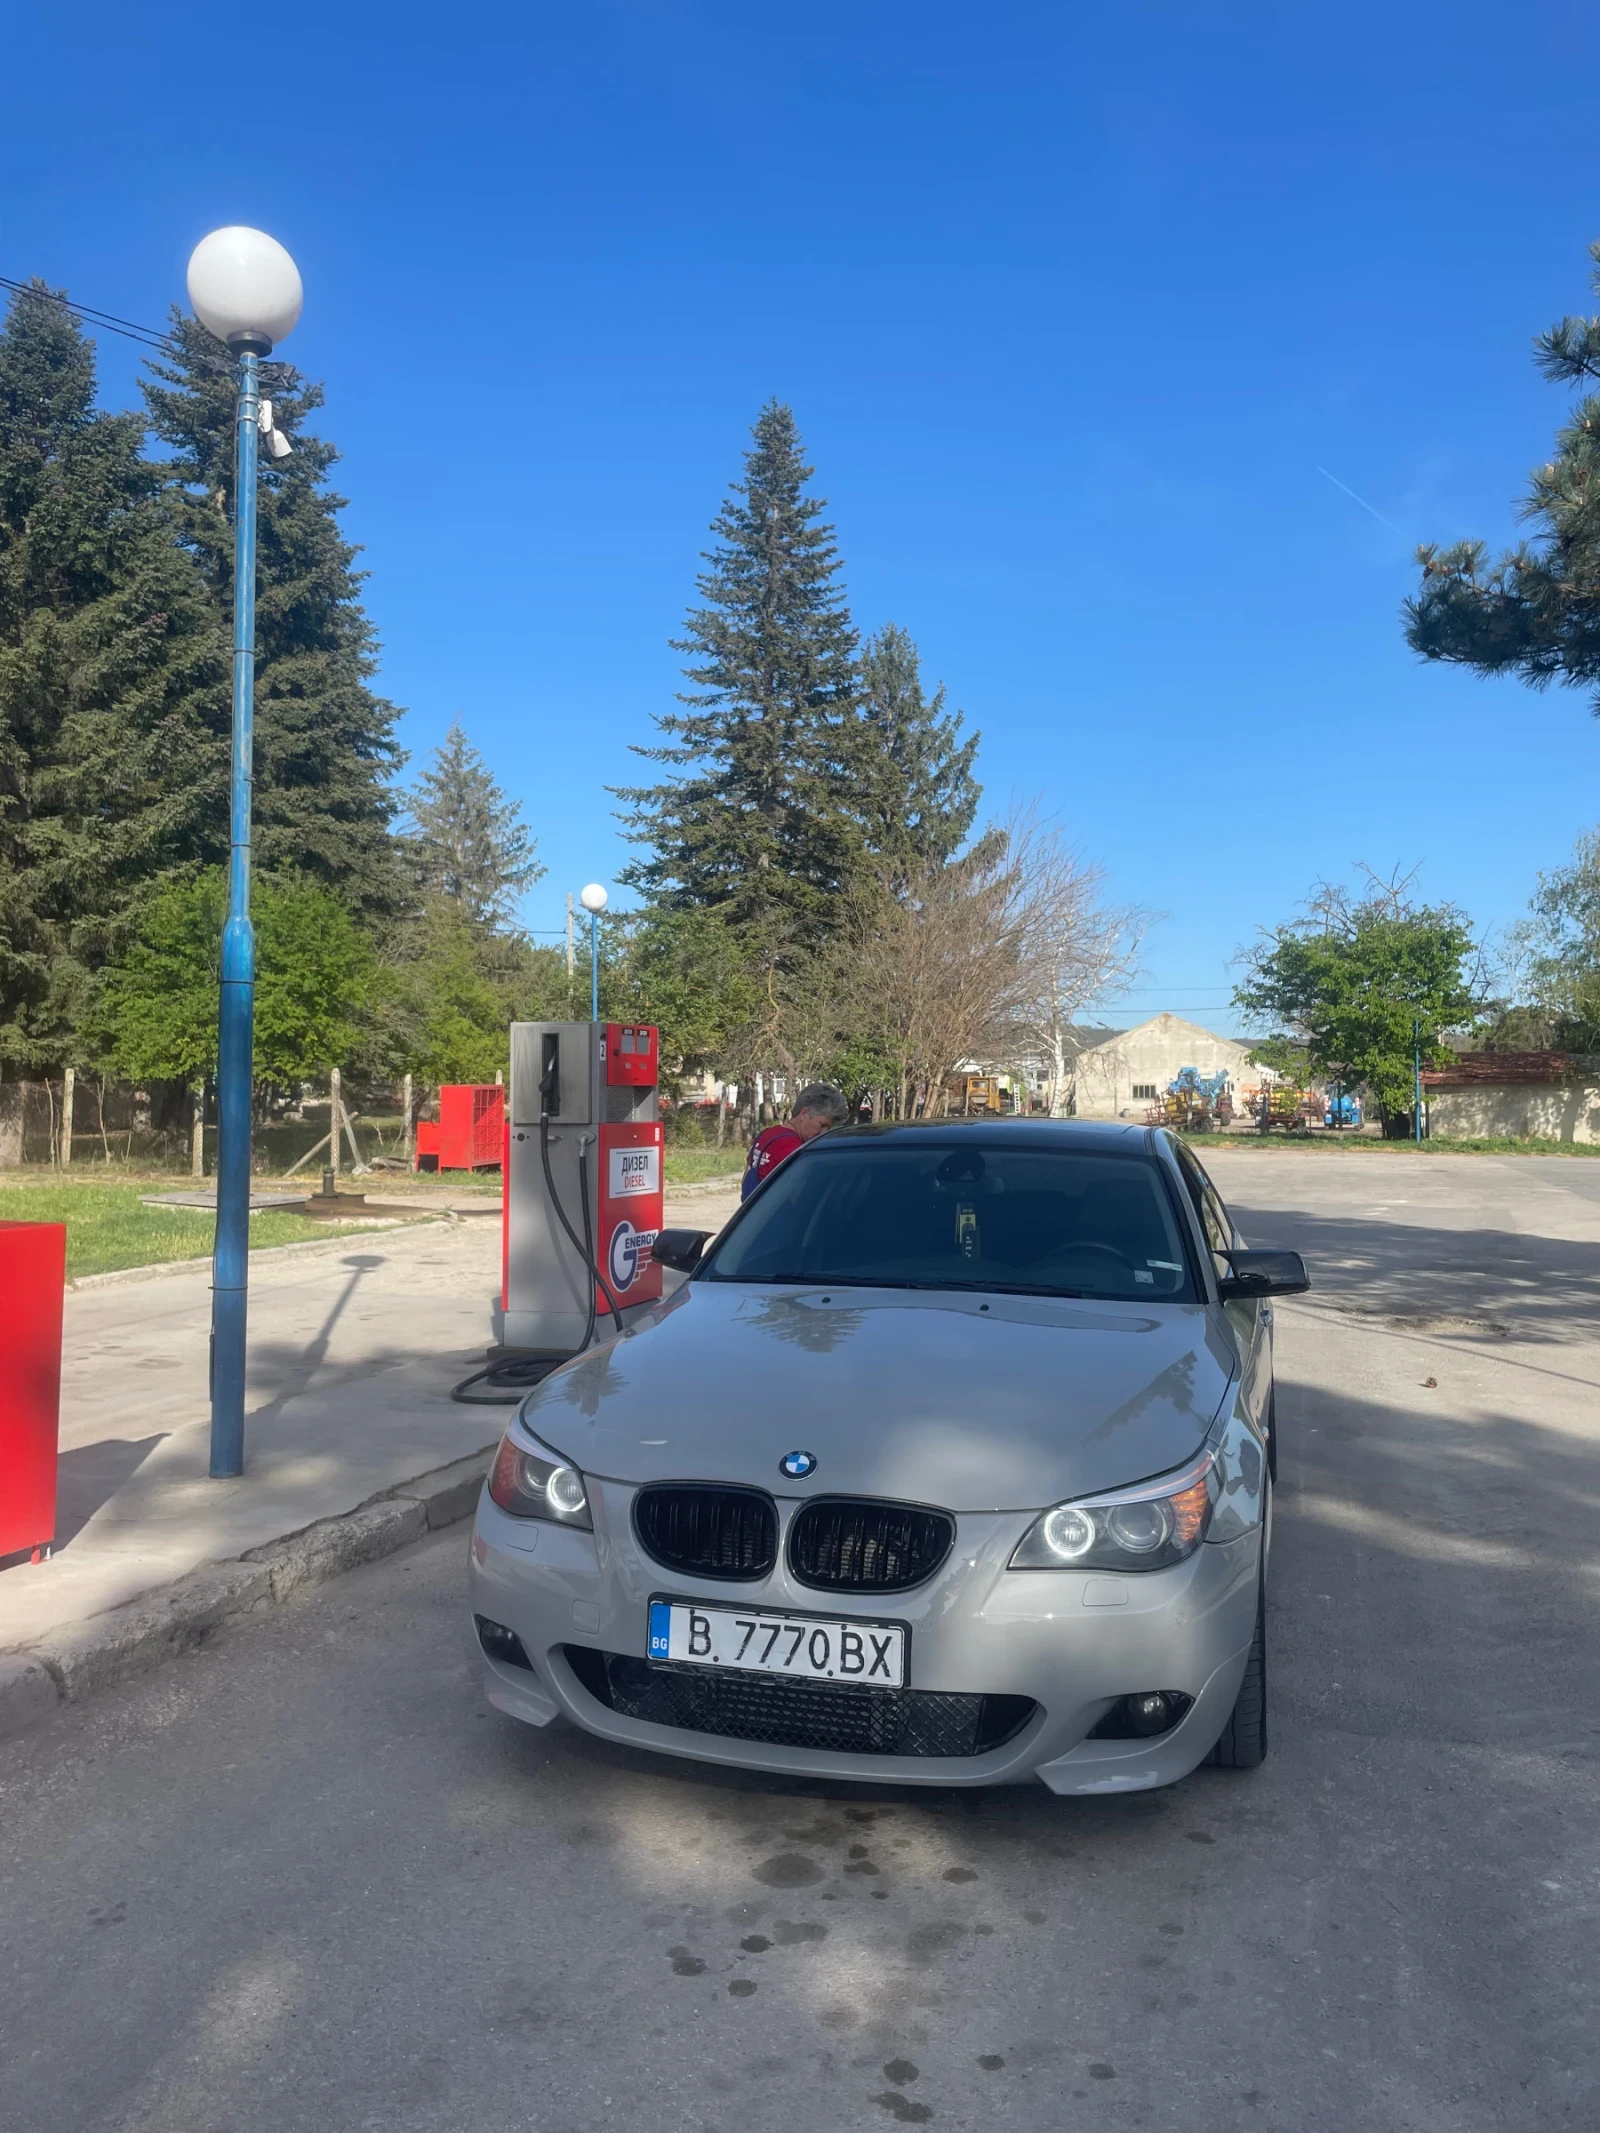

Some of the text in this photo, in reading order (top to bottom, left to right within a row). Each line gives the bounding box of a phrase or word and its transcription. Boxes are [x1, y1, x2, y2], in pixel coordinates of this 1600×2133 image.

[622, 1155, 649, 1176] ДИЗЕЛ
[624, 1174, 646, 1189] DIESEL
[624, 1232, 657, 1250] ENERGY
[652, 1636, 668, 1650] BG
